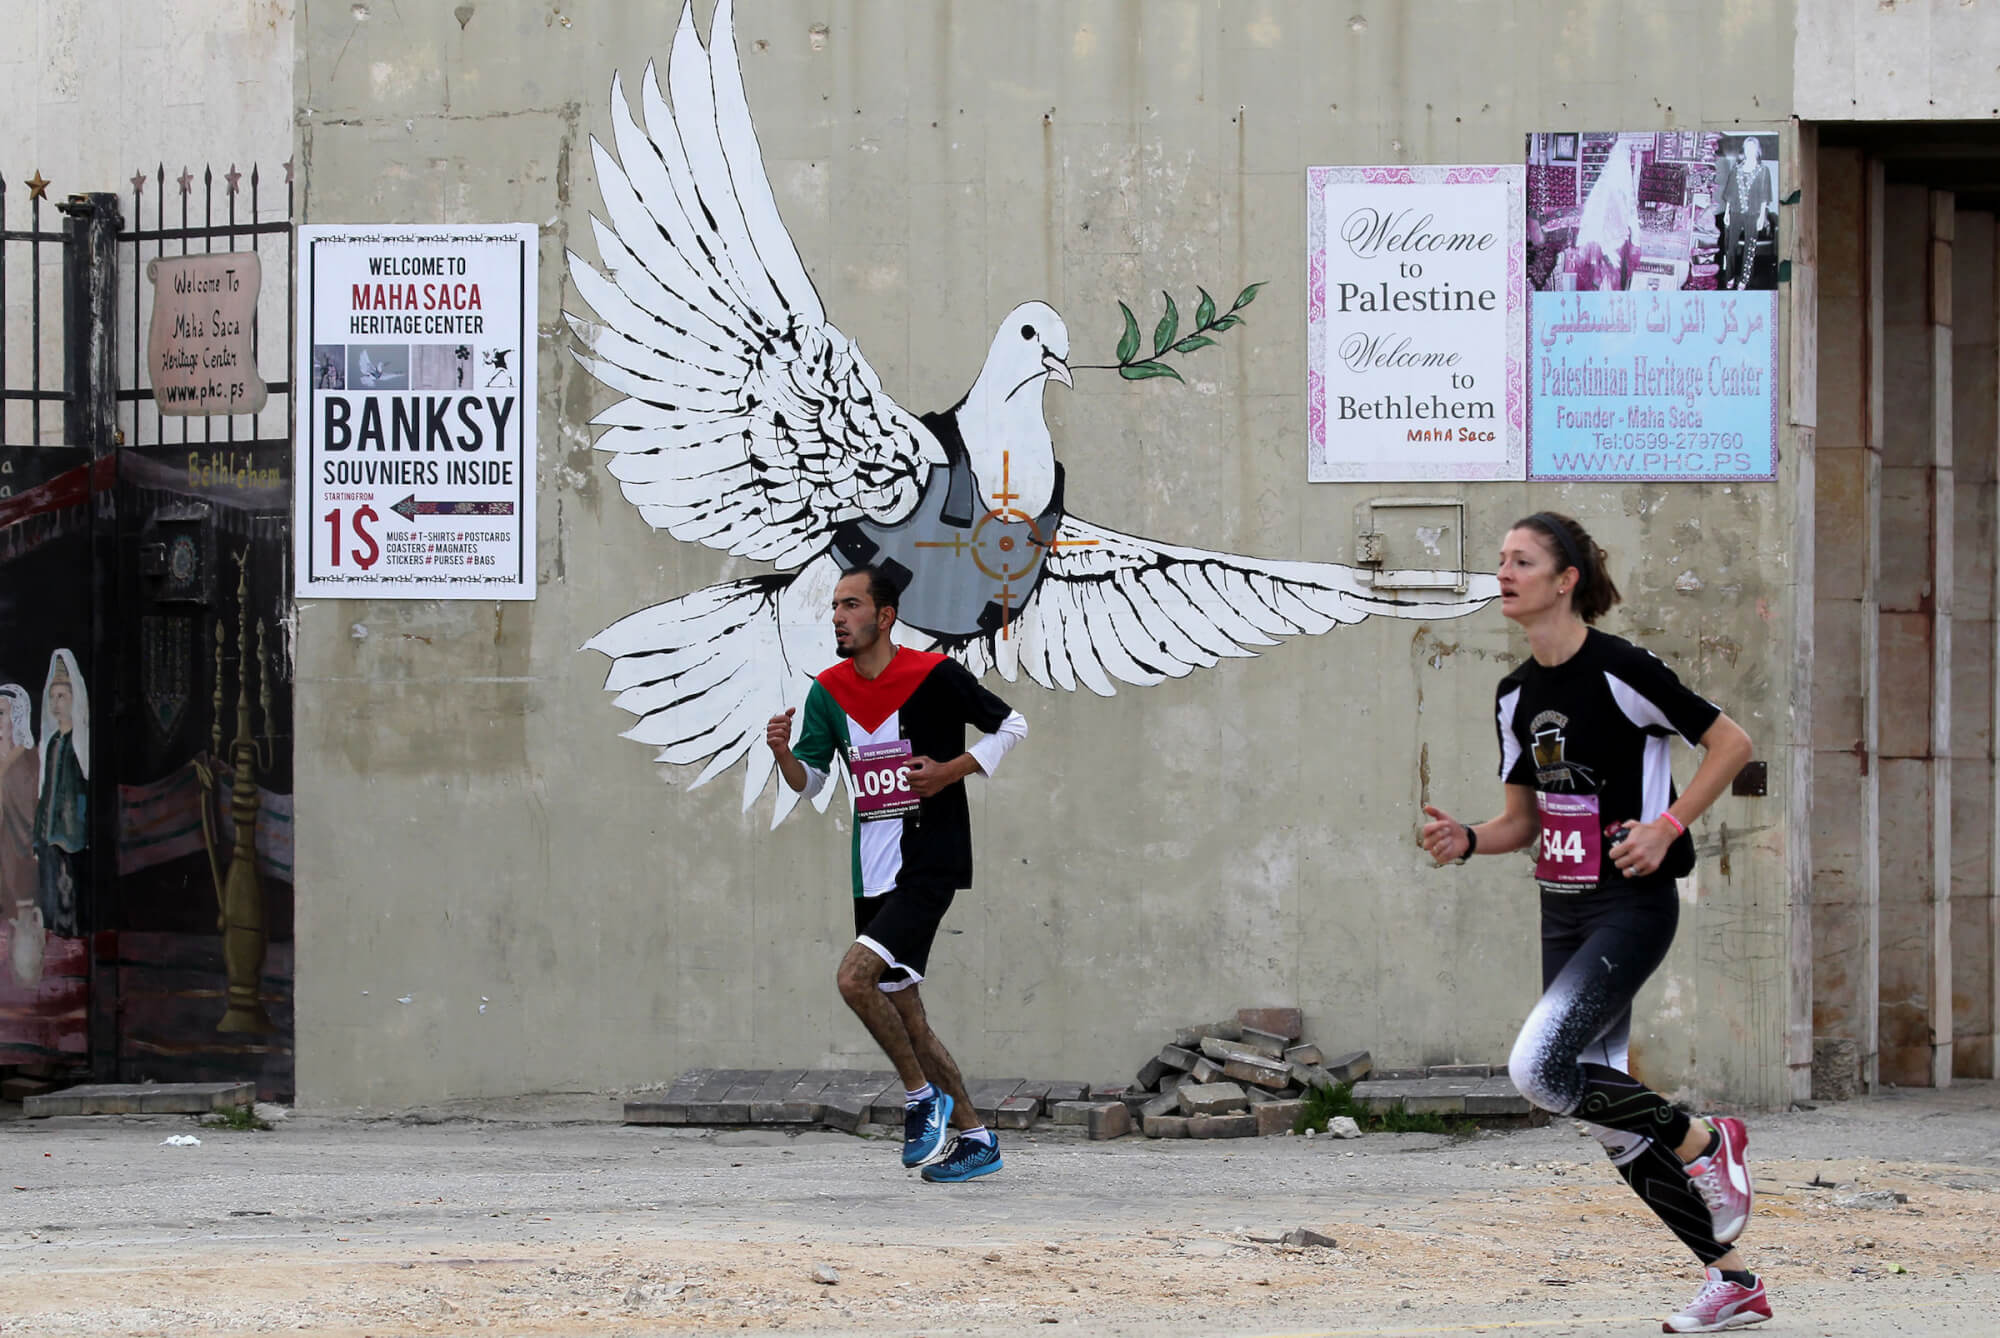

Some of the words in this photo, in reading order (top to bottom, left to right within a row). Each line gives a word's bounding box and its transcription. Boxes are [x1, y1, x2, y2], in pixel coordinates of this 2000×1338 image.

[1341, 207, 1497, 259] Welcome
[369, 257, 444, 276] WELCOME
[448, 257, 466, 275] TO
[1399, 261, 1422, 279] to
[174, 270, 220, 294] Welcome
[226, 270, 240, 293] To
[352, 284, 418, 310] MAHA
[423, 283, 482, 310] SACA
[1337, 282, 1496, 312] Palestine
[172, 313, 204, 339] Maha
[212, 309, 240, 338] Saca
[350, 316, 422, 334] HERITAGE
[425, 316, 484, 334] CENTER
[1646, 296, 1705, 344] التراث
[1714, 298, 1764, 344] مركز
[162, 349, 198, 375] Heritage
[203, 345, 238, 369] Center
[1338, 332, 1462, 373] Welcome
[166, 378, 245, 406] www.phc.ps
[1452, 371, 1474, 389] to
[1540, 355, 1628, 397] Palestinian
[1634, 355, 1703, 408] Heritage
[1708, 355, 1764, 397] Center
[1338, 396, 1495, 420] Bethlehem
[1556, 405, 1615, 429] Founder
[1628, 405, 1665, 429] Maha
[1669, 405, 1704, 429] Saca
[325, 396, 515, 452] BANKSY
[188, 451, 281, 488] Bethlehem
[323, 460, 438, 486] SOUVNIERS
[447, 460, 513, 486] INSIDE
[1553, 453, 1752, 472] WWW.PHC.PS
[324, 492, 355, 501] STARTING
[355, 492, 374, 501] FROM
[386, 531, 409, 542] MUGS
[419, 531, 456, 542] T-SHIRTS
[464, 531, 511, 542] POSTCARDS
[386, 543, 426, 554] COASTERS
[435, 543, 478, 554] MAGNATES
[386, 555, 424, 566] STICKERS
[434, 555, 464, 566] PURSES
[474, 555, 496, 566] BAGS
